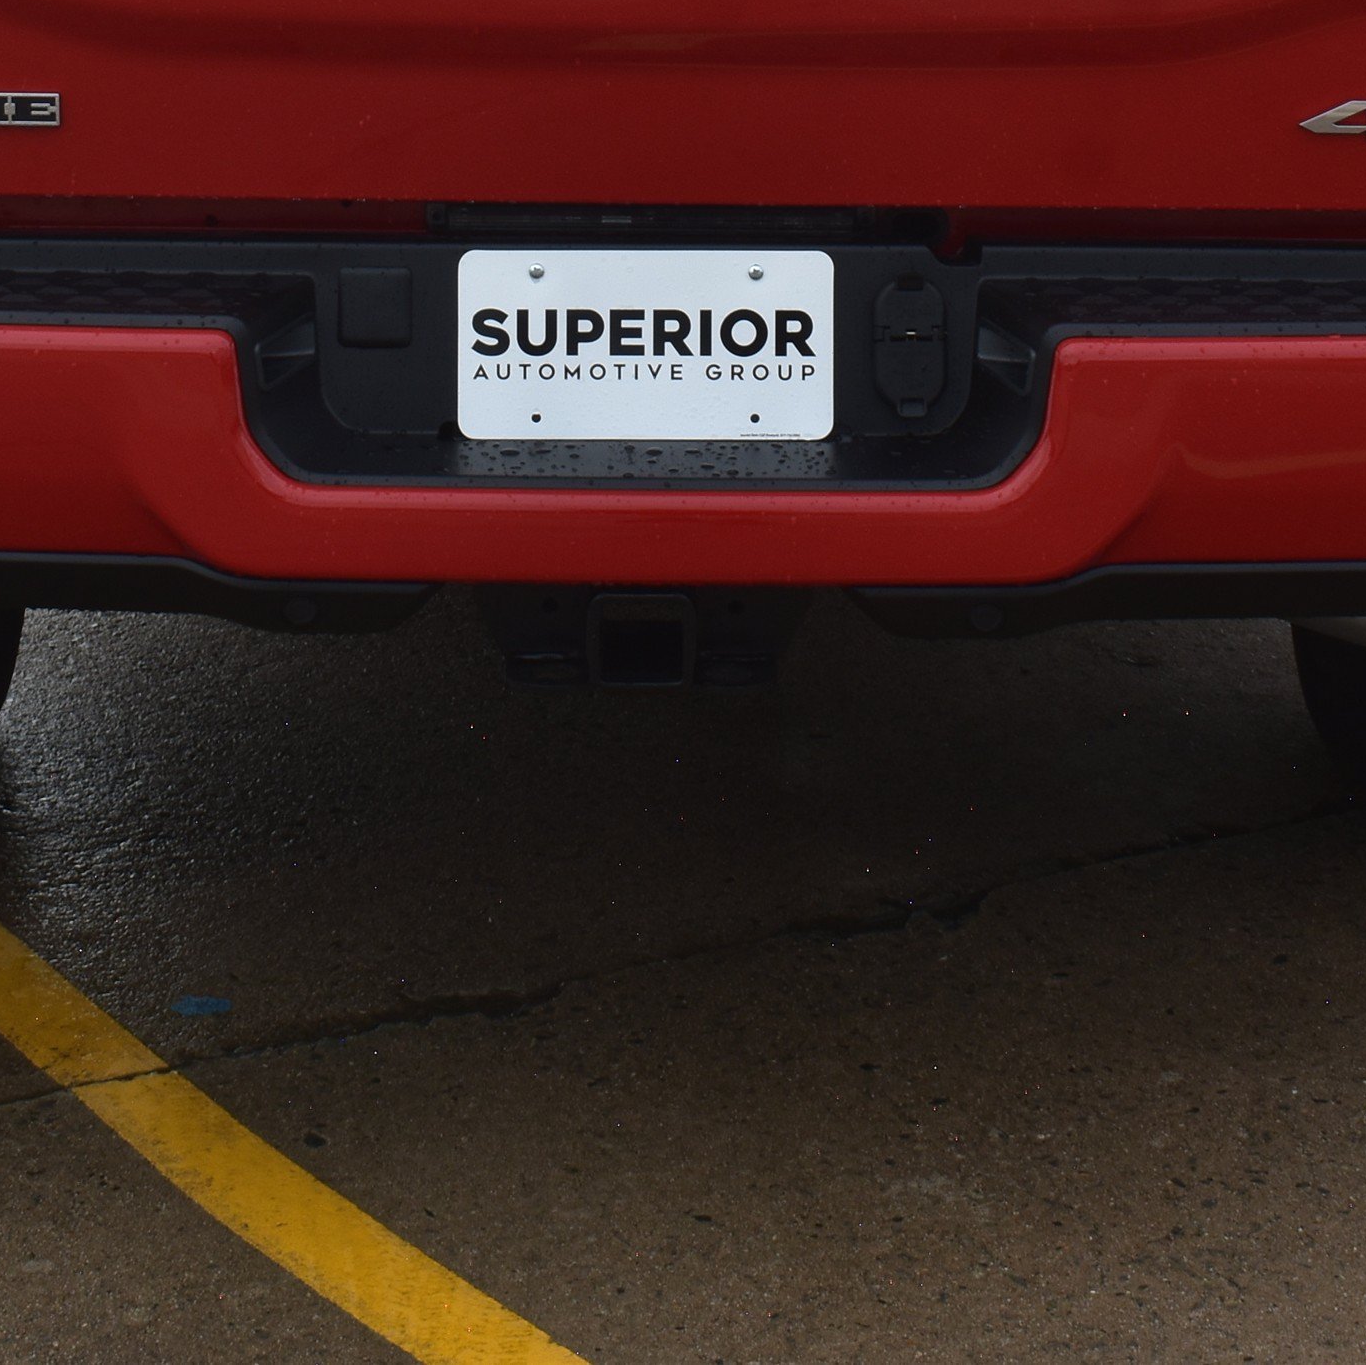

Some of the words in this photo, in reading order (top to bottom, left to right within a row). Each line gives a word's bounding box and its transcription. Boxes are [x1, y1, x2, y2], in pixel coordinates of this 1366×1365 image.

[471, 308, 816, 357] SUPERIOR
[473, 364, 684, 381] AUTOMOTIVE
[706, 364, 816, 381] GROUP
